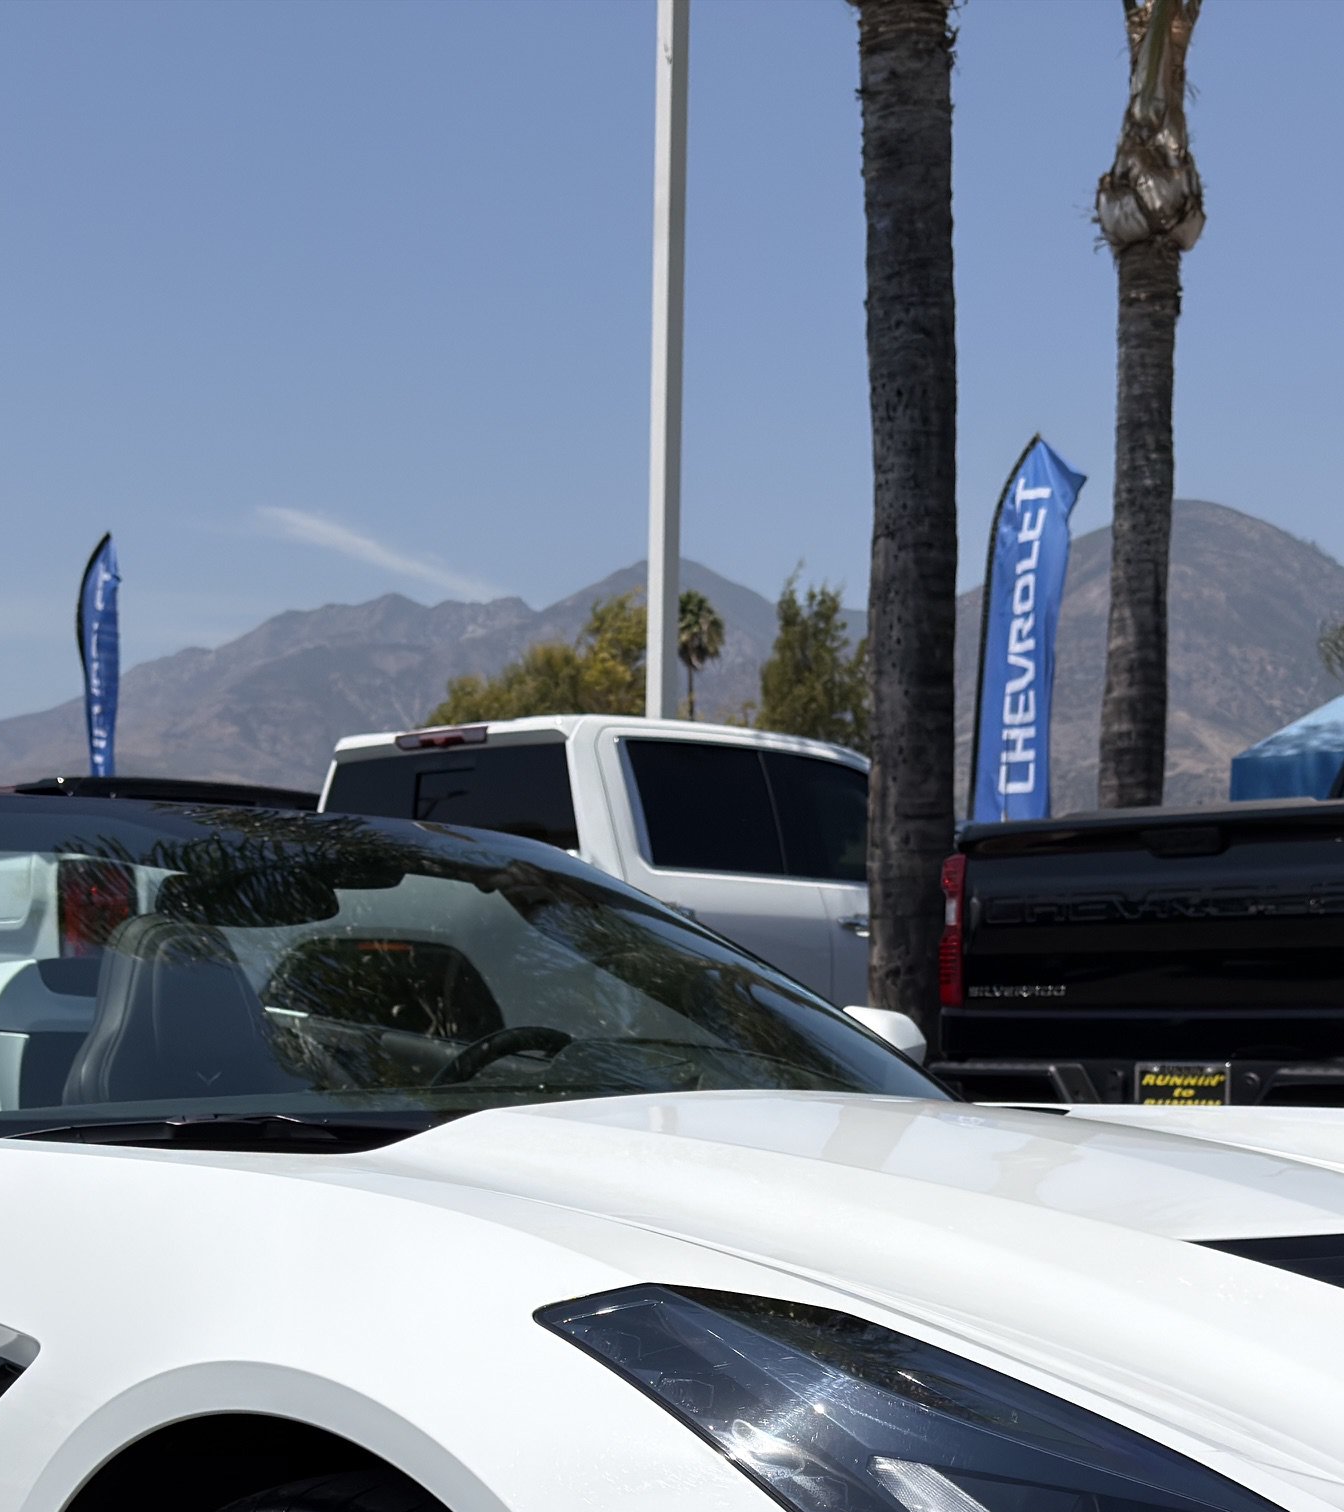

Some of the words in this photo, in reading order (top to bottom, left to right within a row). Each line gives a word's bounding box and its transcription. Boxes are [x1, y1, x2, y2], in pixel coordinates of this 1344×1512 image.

[998, 477, 1052, 796] CHEVROLET
[1141, 1073, 1226, 1087] RUNNIN'
[1172, 1087, 1196, 1098] to
